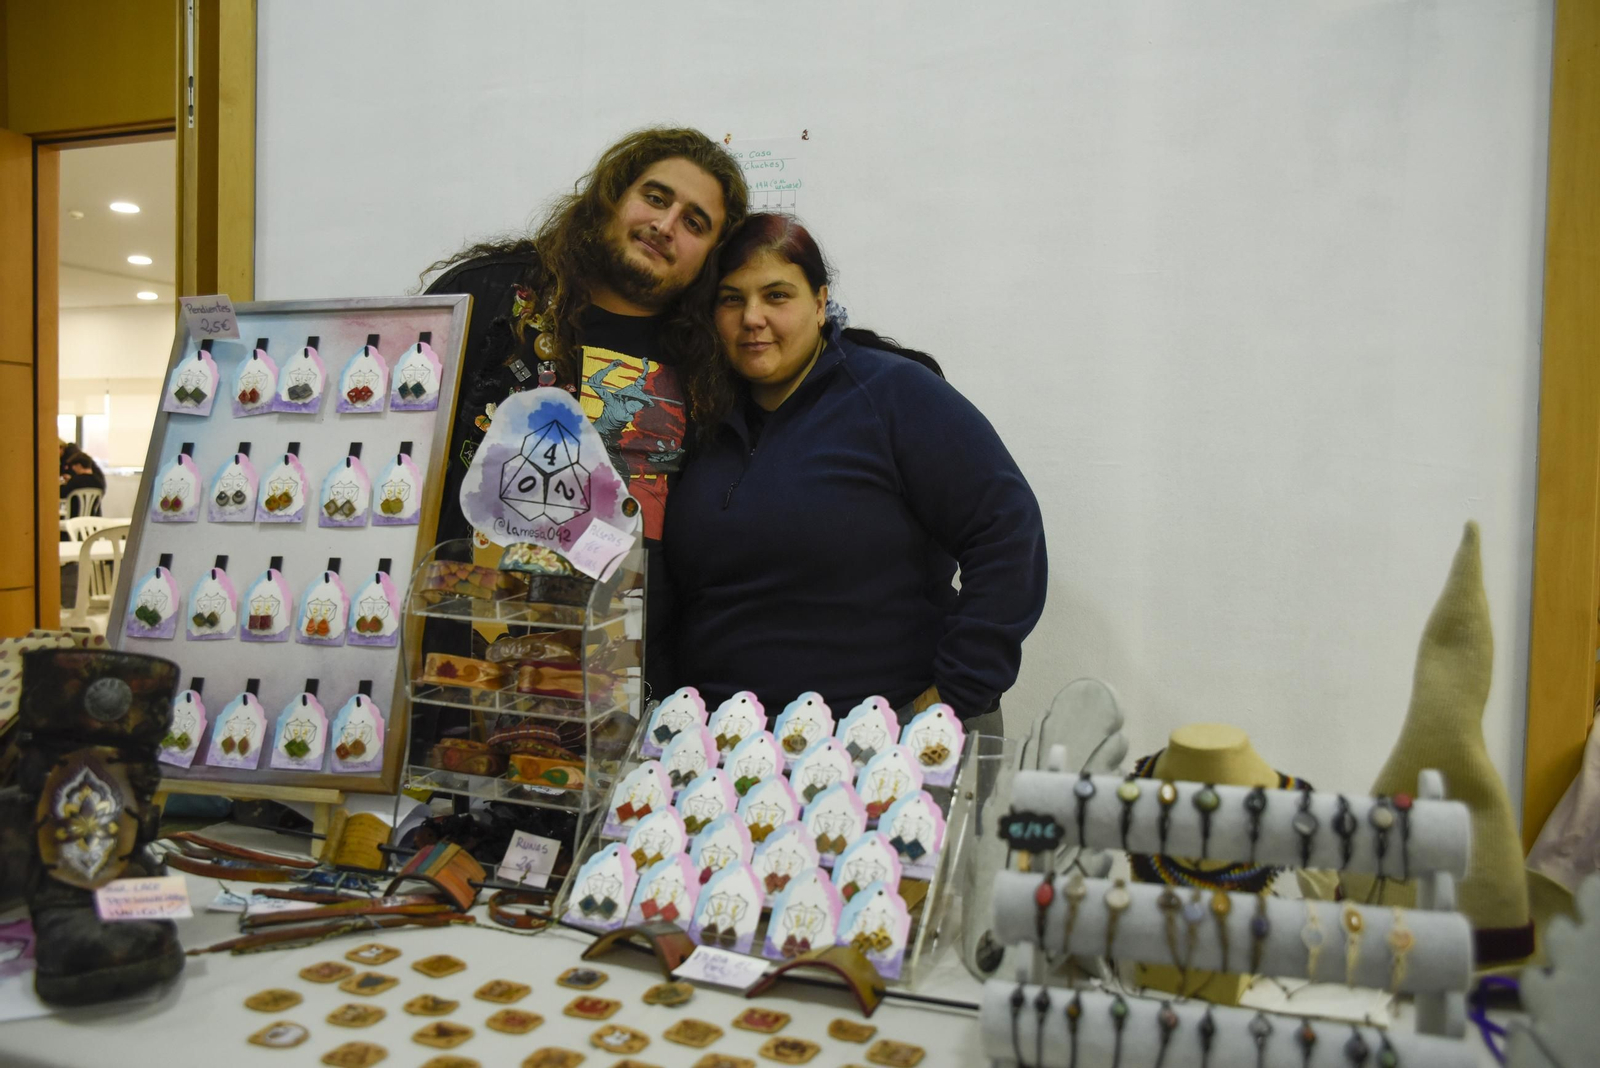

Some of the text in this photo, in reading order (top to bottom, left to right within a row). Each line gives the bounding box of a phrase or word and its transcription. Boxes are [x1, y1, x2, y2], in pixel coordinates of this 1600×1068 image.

[749, 150, 772, 159] Casa
[185, 301, 231, 314] Pendientes
[200, 318, 231, 335] 2,5€
[543, 443, 558, 467] 4
[493, 517, 572, 542] @lamesa042
[515, 836, 549, 854] RUNAS
